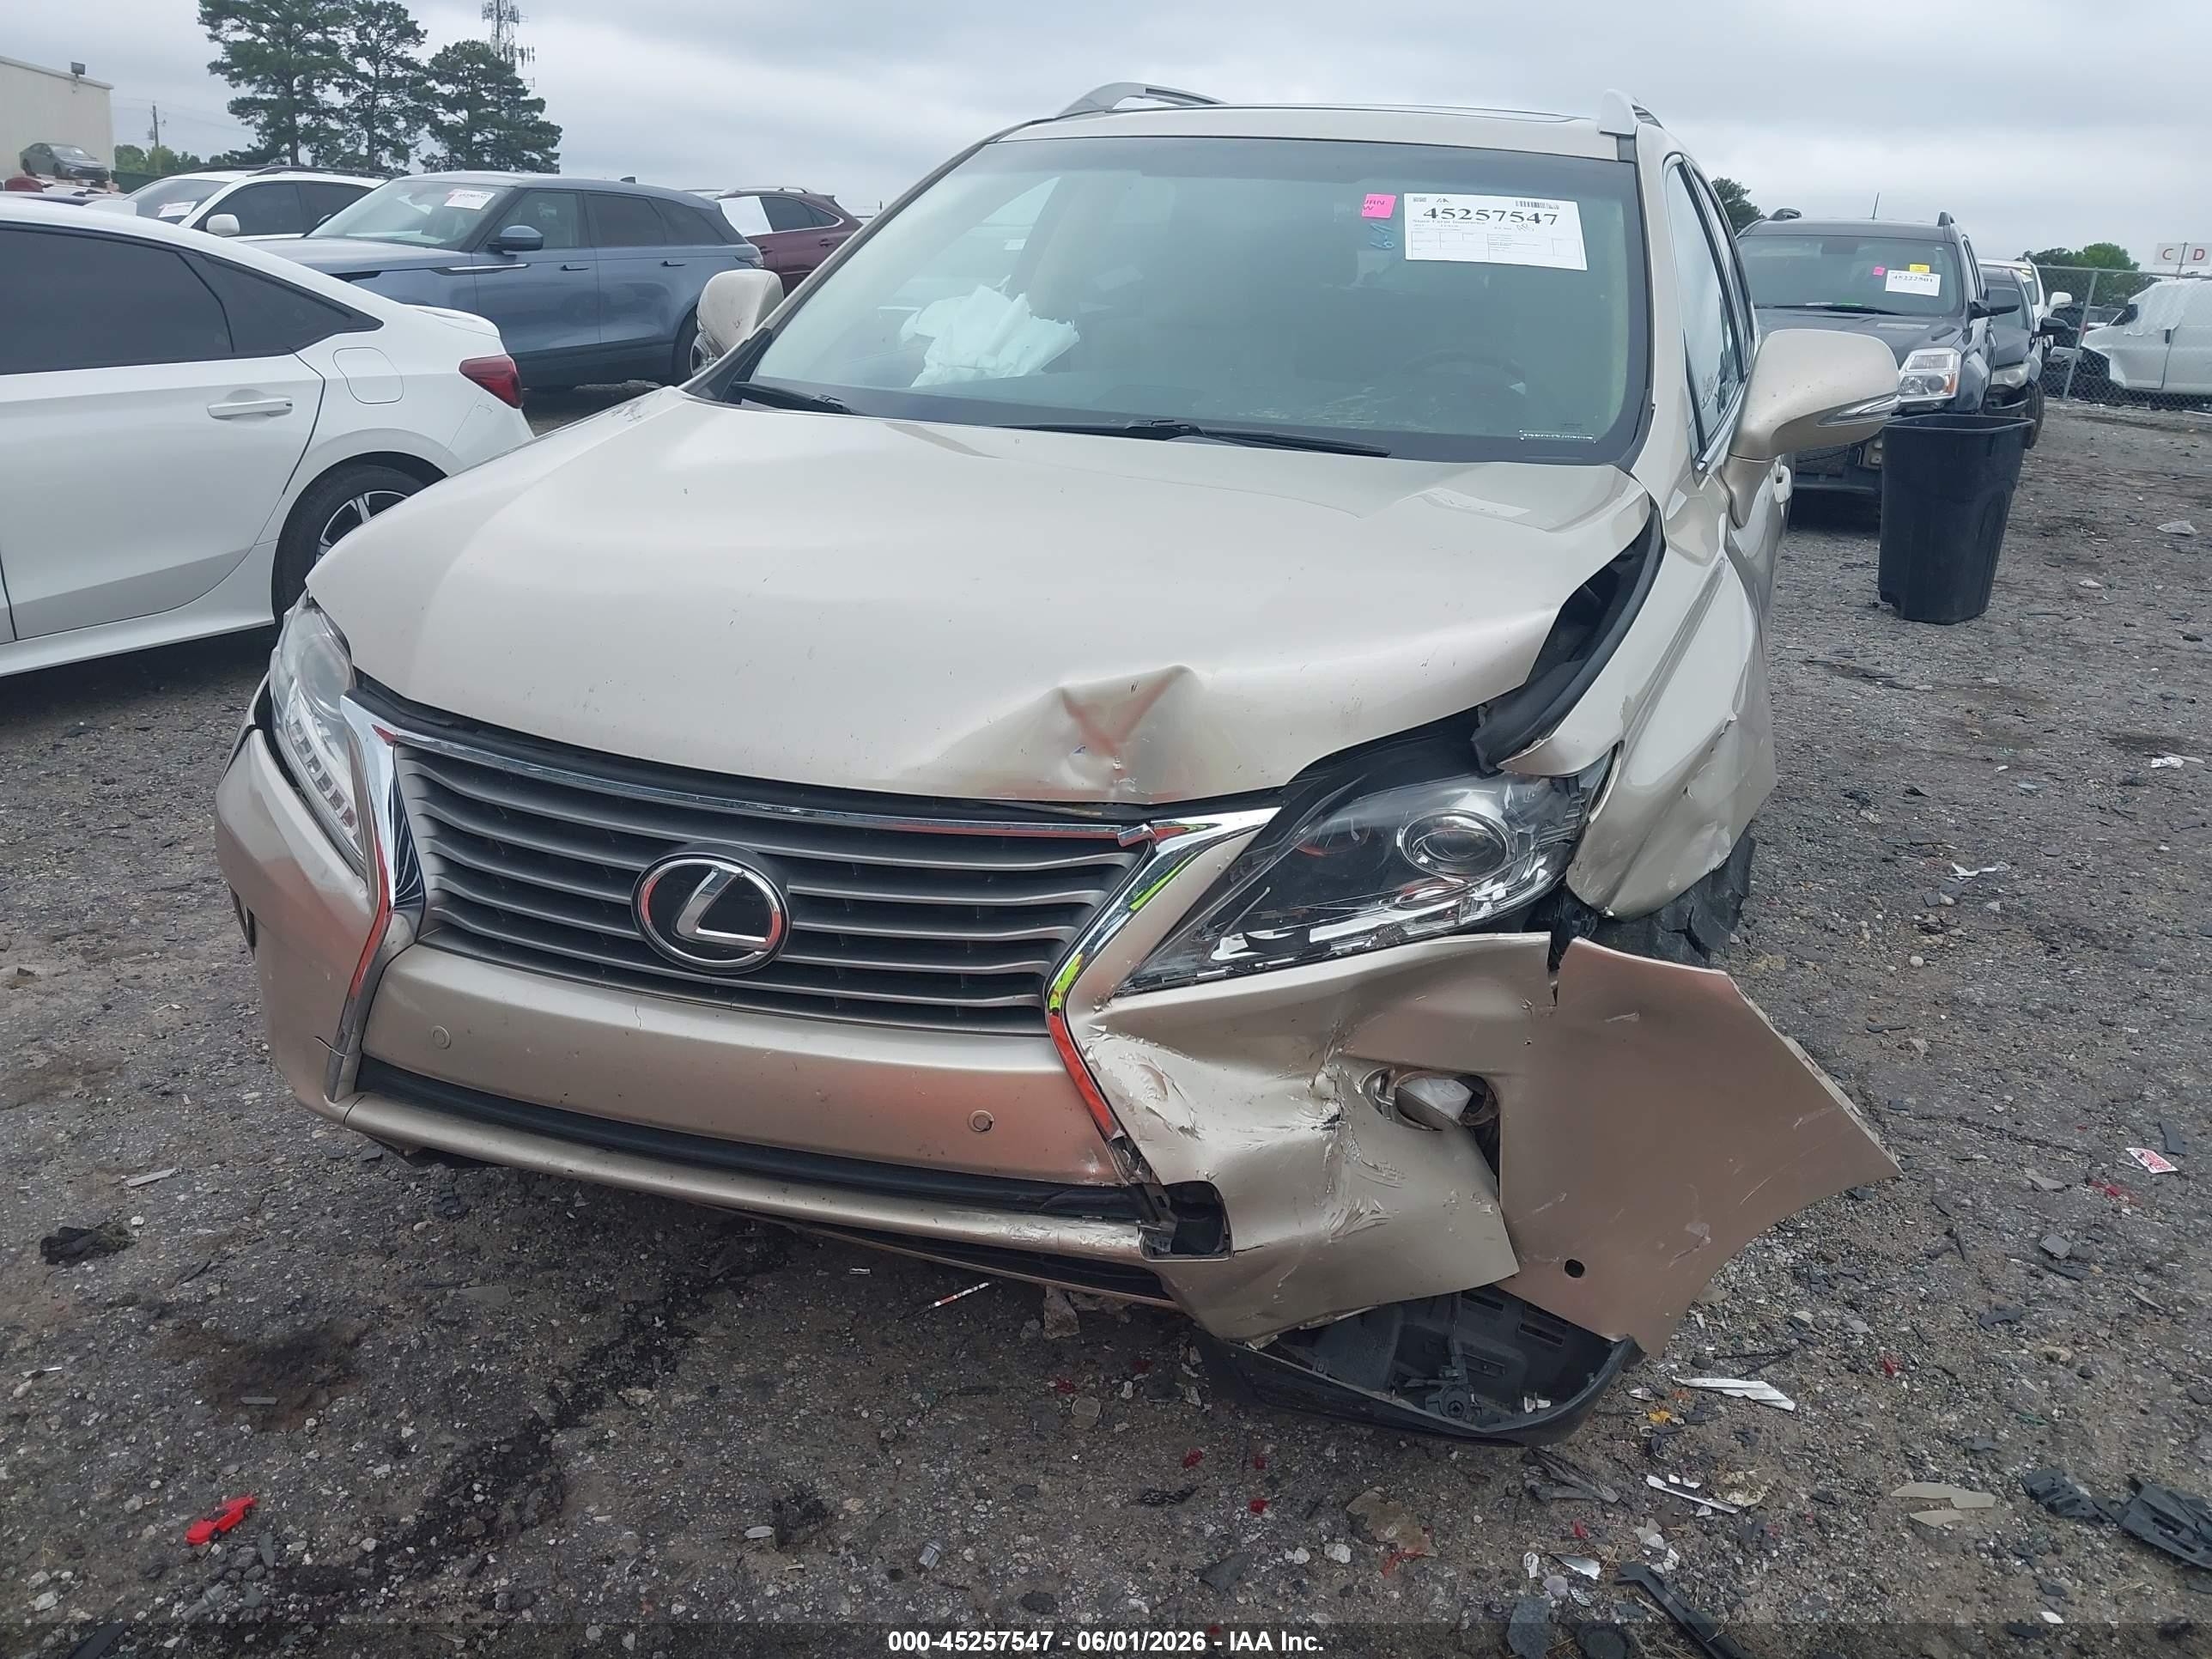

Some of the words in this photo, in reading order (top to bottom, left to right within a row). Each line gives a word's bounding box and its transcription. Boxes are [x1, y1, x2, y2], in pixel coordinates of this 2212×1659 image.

[1423, 207, 1559, 226] 45257547
[2162, 248, 2175, 261] C
[2192, 248, 2206, 261] D
